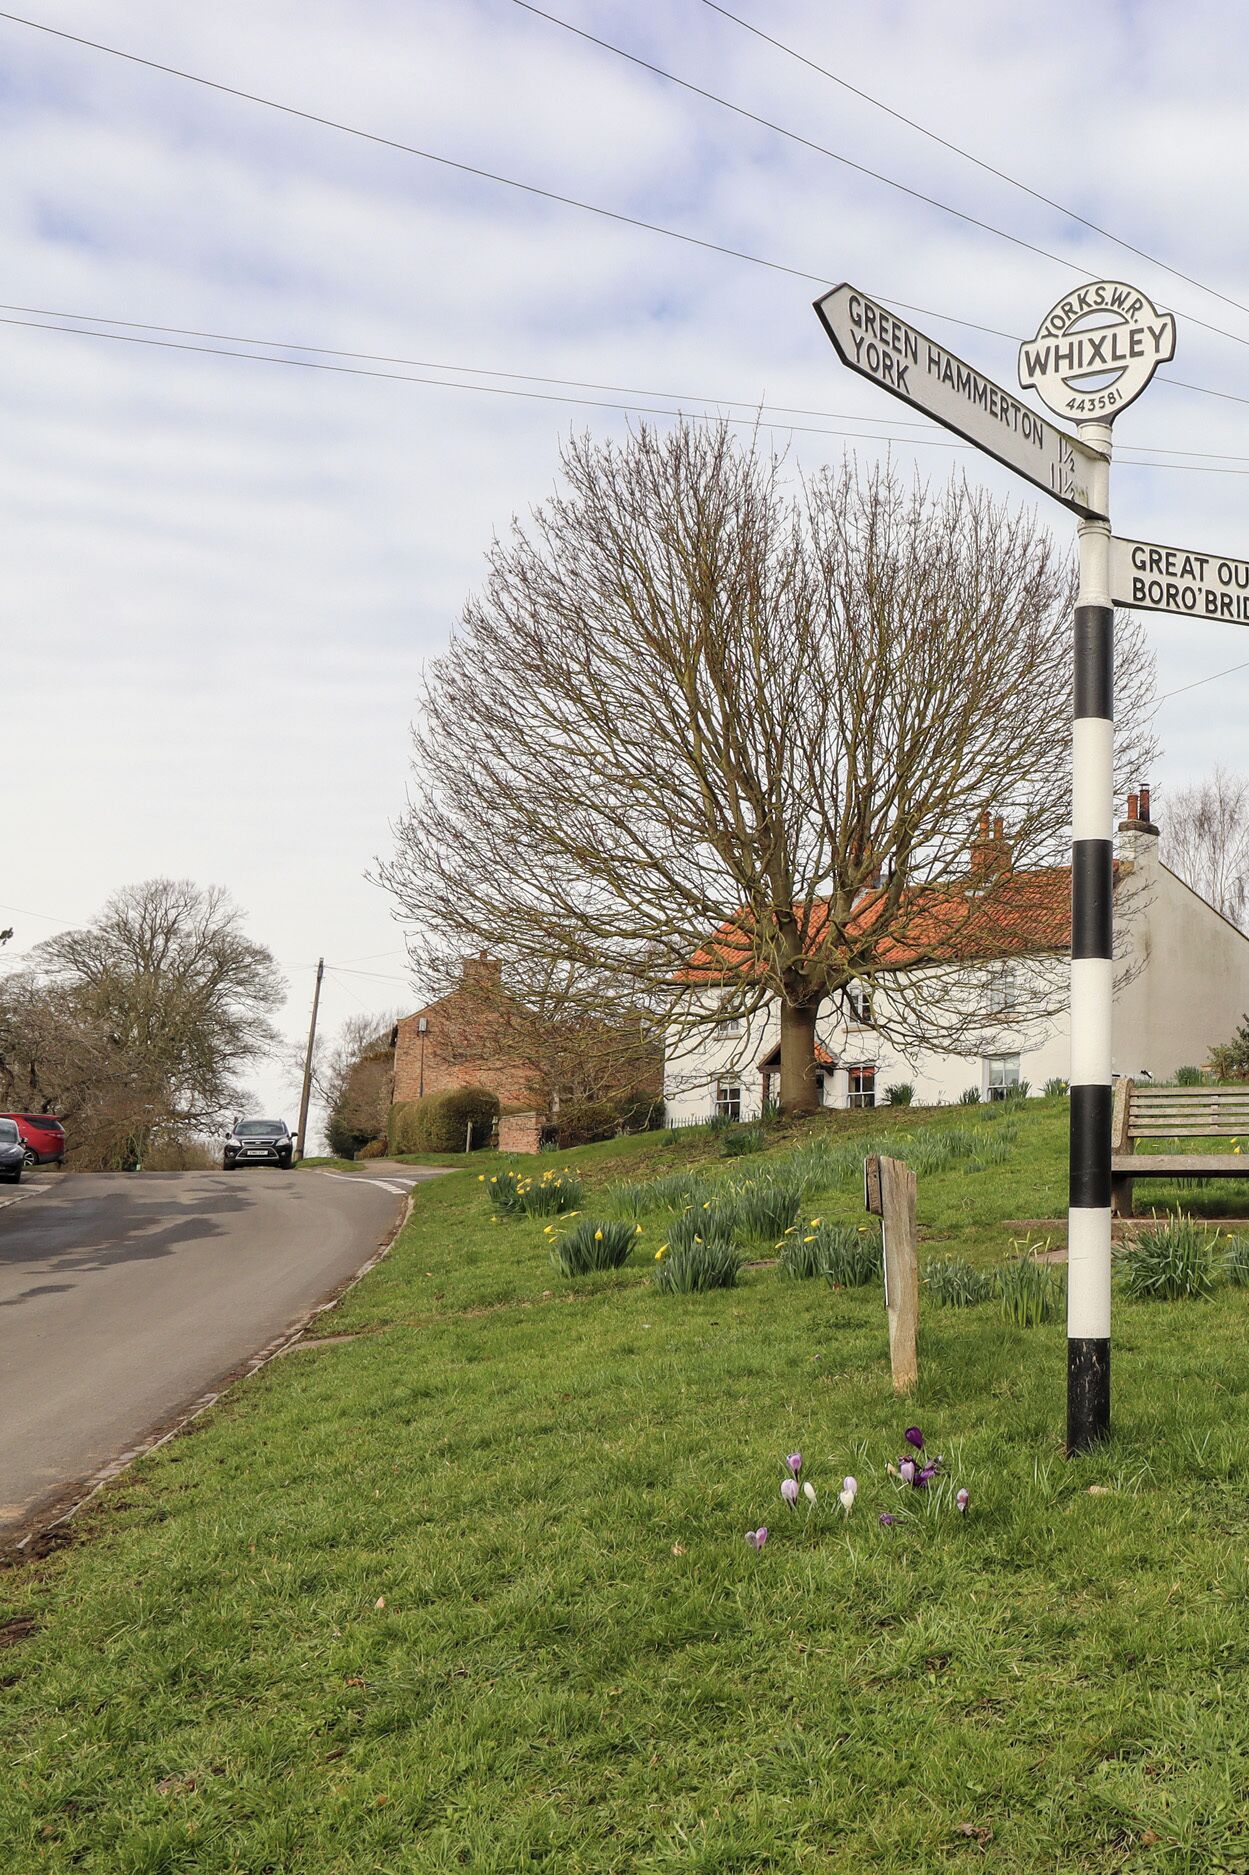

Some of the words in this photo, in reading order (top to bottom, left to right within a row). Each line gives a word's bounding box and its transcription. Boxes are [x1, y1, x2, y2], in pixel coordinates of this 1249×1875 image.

[848, 294, 918, 365] GREEN
[927, 344, 1044, 450] HAMMERTON
[850, 328, 911, 395] YORK
[1024, 322, 1168, 378] WHIXLEY
[1065, 388, 1123, 413] 443581
[1131, 546, 1210, 582] GREAT
